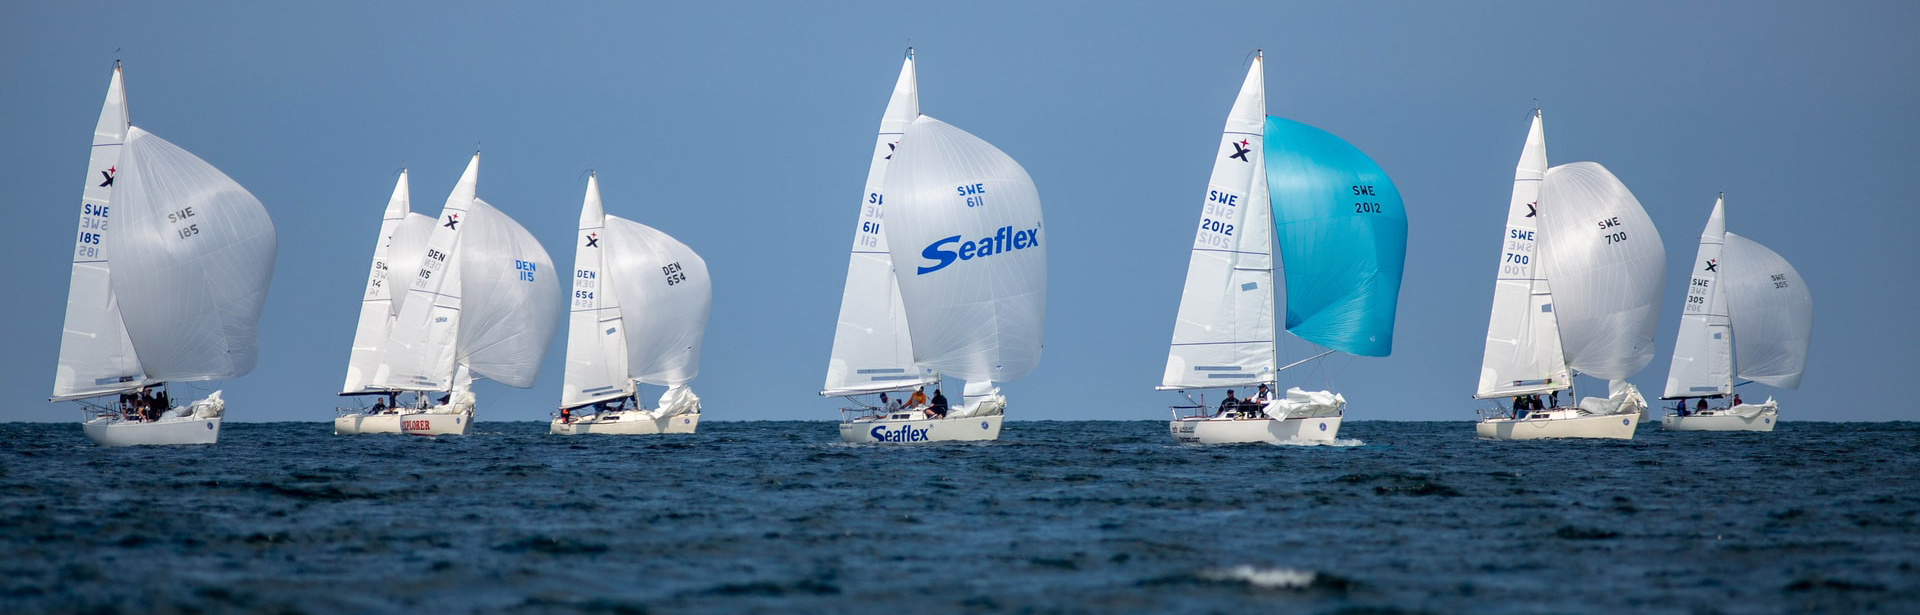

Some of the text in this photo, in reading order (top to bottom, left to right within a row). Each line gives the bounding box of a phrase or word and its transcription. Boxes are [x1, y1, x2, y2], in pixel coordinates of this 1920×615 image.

[957, 183, 986, 196] SWE
[1352, 185, 1376, 196] SWE
[966, 196, 984, 208] 611
[1209, 190, 1238, 207] SWE
[84, 204, 109, 217] SWE
[1354, 202, 1382, 214] 2012
[168, 206, 195, 223] SWE
[863, 221, 880, 235] 611
[1202, 218, 1234, 236] 2012
[1598, 216, 1621, 230] SWE
[80, 232, 100, 244] 185
[178, 224, 199, 240] 185
[1510, 229, 1534, 241] SWE
[1605, 231, 1627, 245] 700
[428, 249, 446, 262] DEN
[917, 225, 1039, 275] Seaflex
[1507, 253, 1529, 265] 700
[376, 262, 388, 270] SW
[516, 260, 536, 272] DEN
[662, 262, 682, 276] DEN
[419, 269, 432, 279] 115
[520, 272, 534, 282] 115
[577, 270, 596, 279] DEN
[667, 272, 686, 286] 654
[1692, 279, 1709, 288] SWE
[1774, 281, 1788, 289] 305
[575, 290, 594, 300] 654
[1688, 296, 1704, 304] 305
[871, 425, 929, 442] Seaflex
